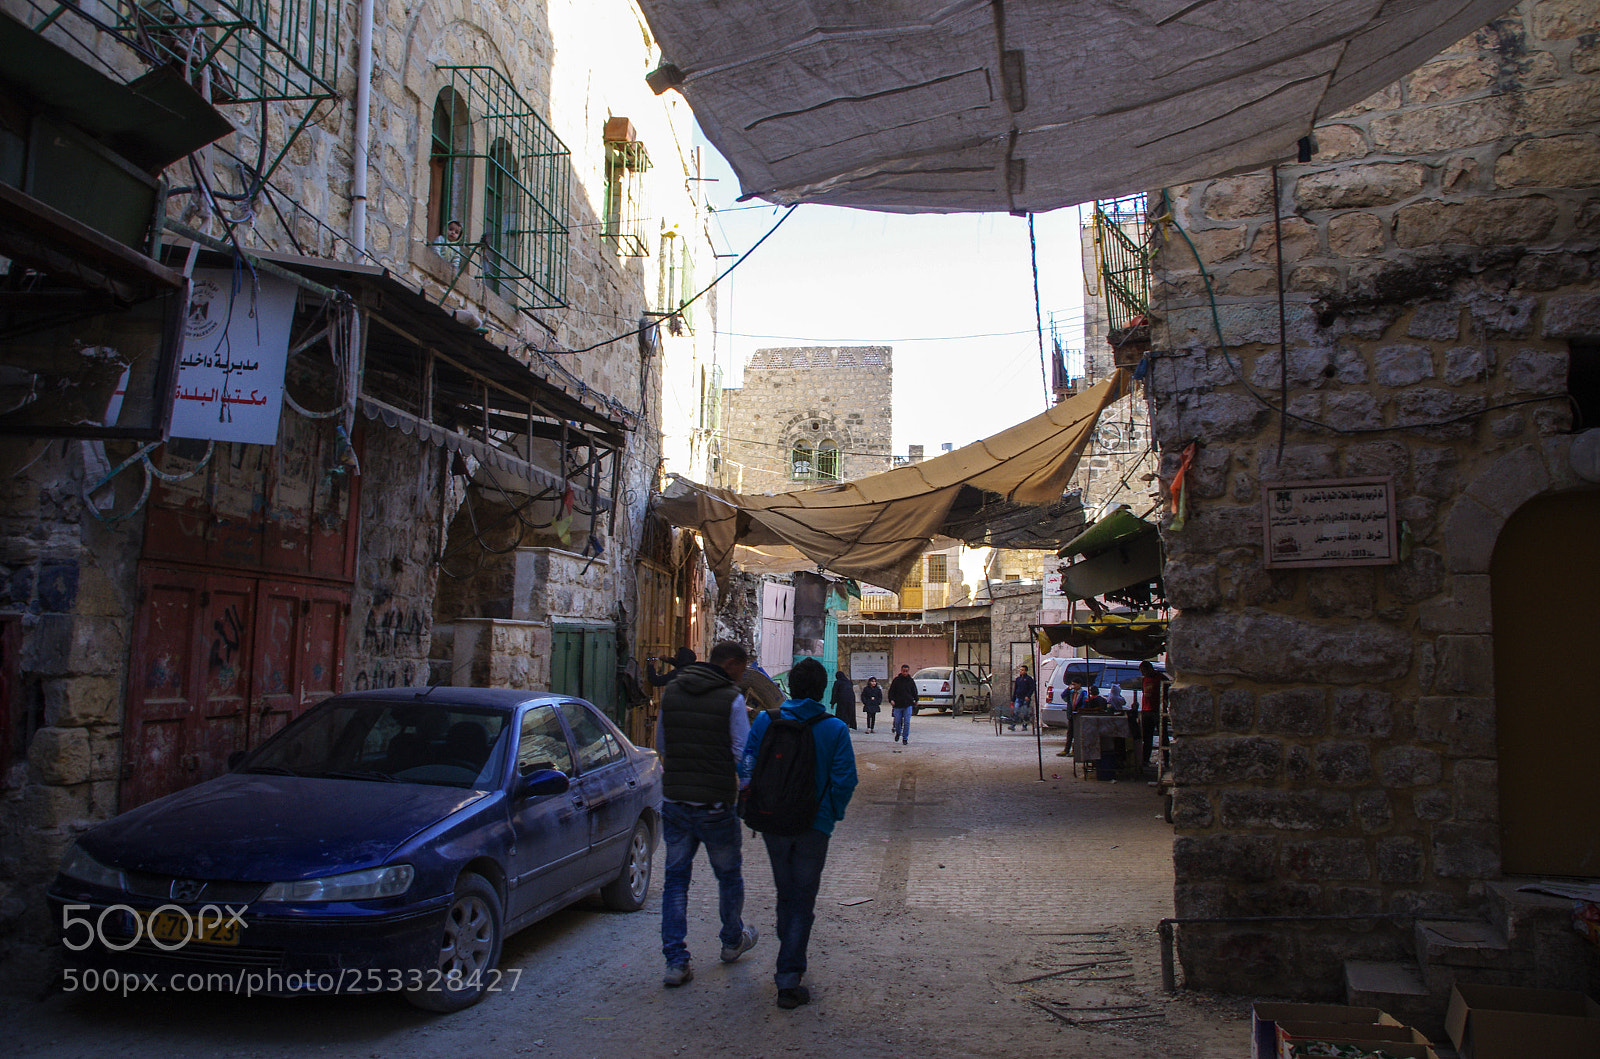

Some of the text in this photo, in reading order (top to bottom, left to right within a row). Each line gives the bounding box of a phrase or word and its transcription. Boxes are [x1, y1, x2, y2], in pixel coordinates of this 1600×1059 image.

[180, 352, 259, 375] مديرية داخلي
[175, 386, 267, 407] مكتب البلدة
